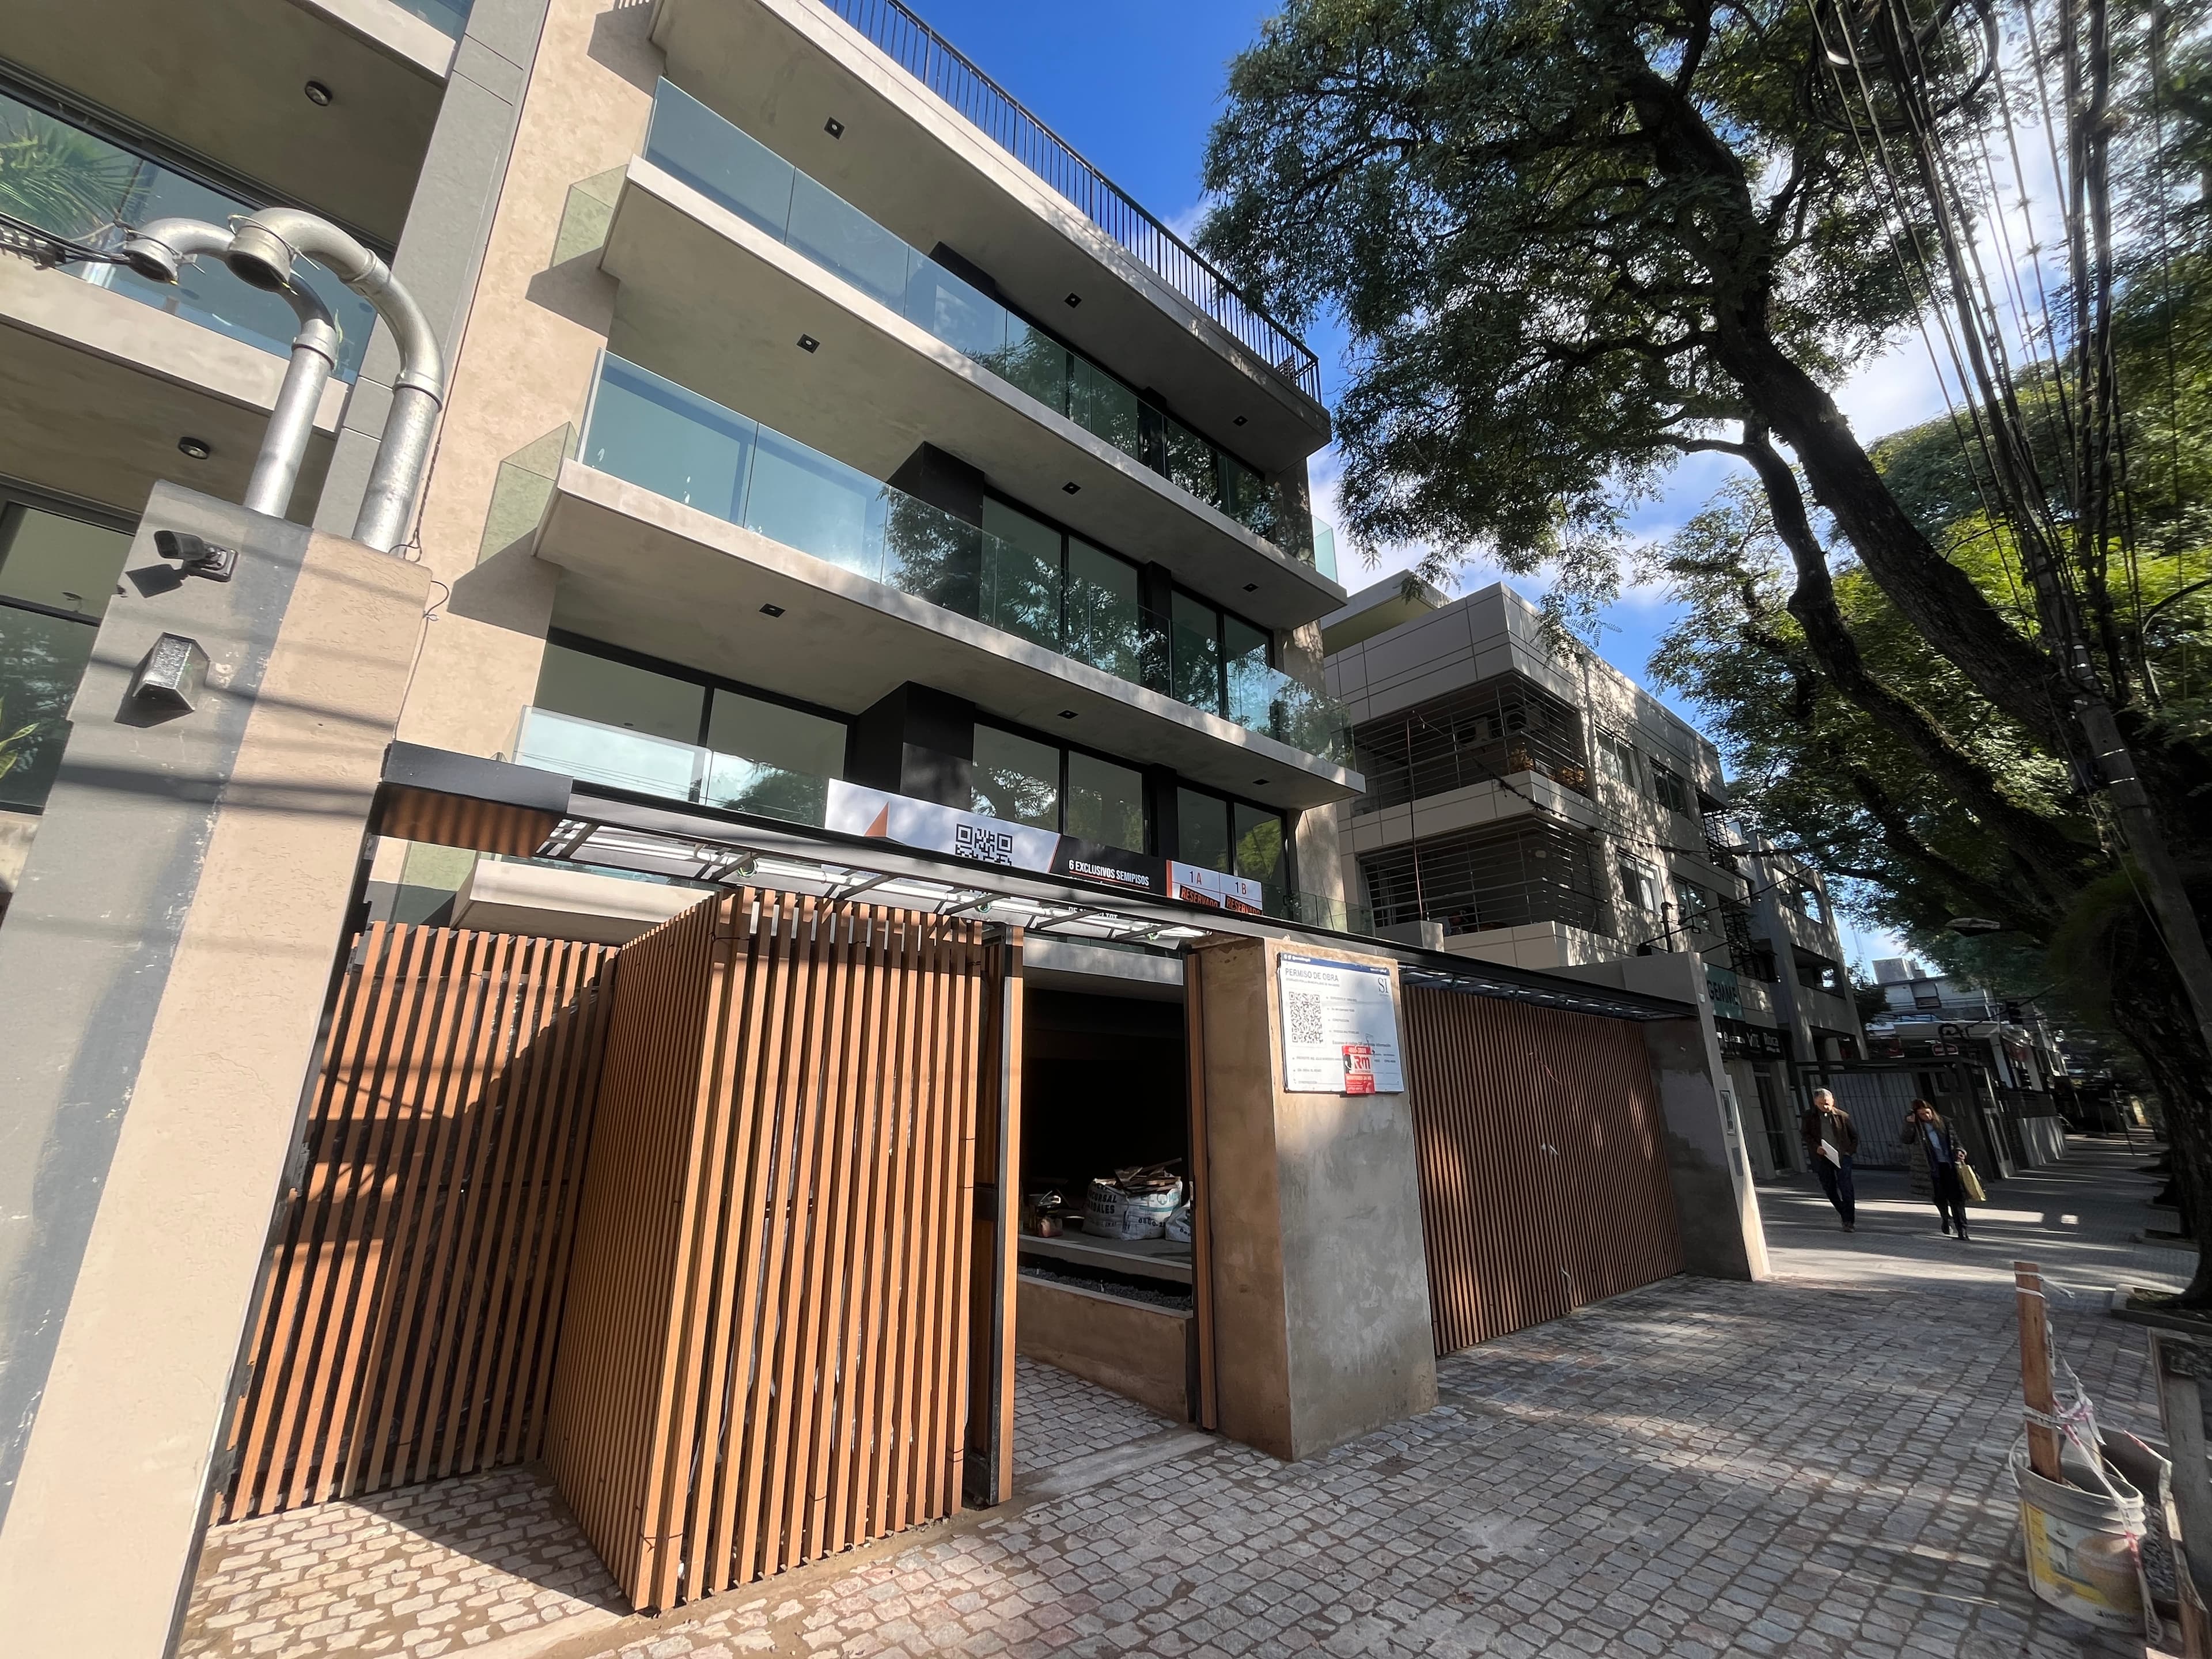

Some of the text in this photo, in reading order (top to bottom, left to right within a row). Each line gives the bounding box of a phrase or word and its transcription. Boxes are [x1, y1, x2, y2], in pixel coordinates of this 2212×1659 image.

[1069, 859, 1074, 870] 6
[1075, 861, 1115, 878] EXCLUSIVOS
[1116, 870, 1149, 886] SEMIPISOS
[1285, 968, 1339, 982] PERMISO DE OBRA
[1378, 977, 1388, 993] SI
